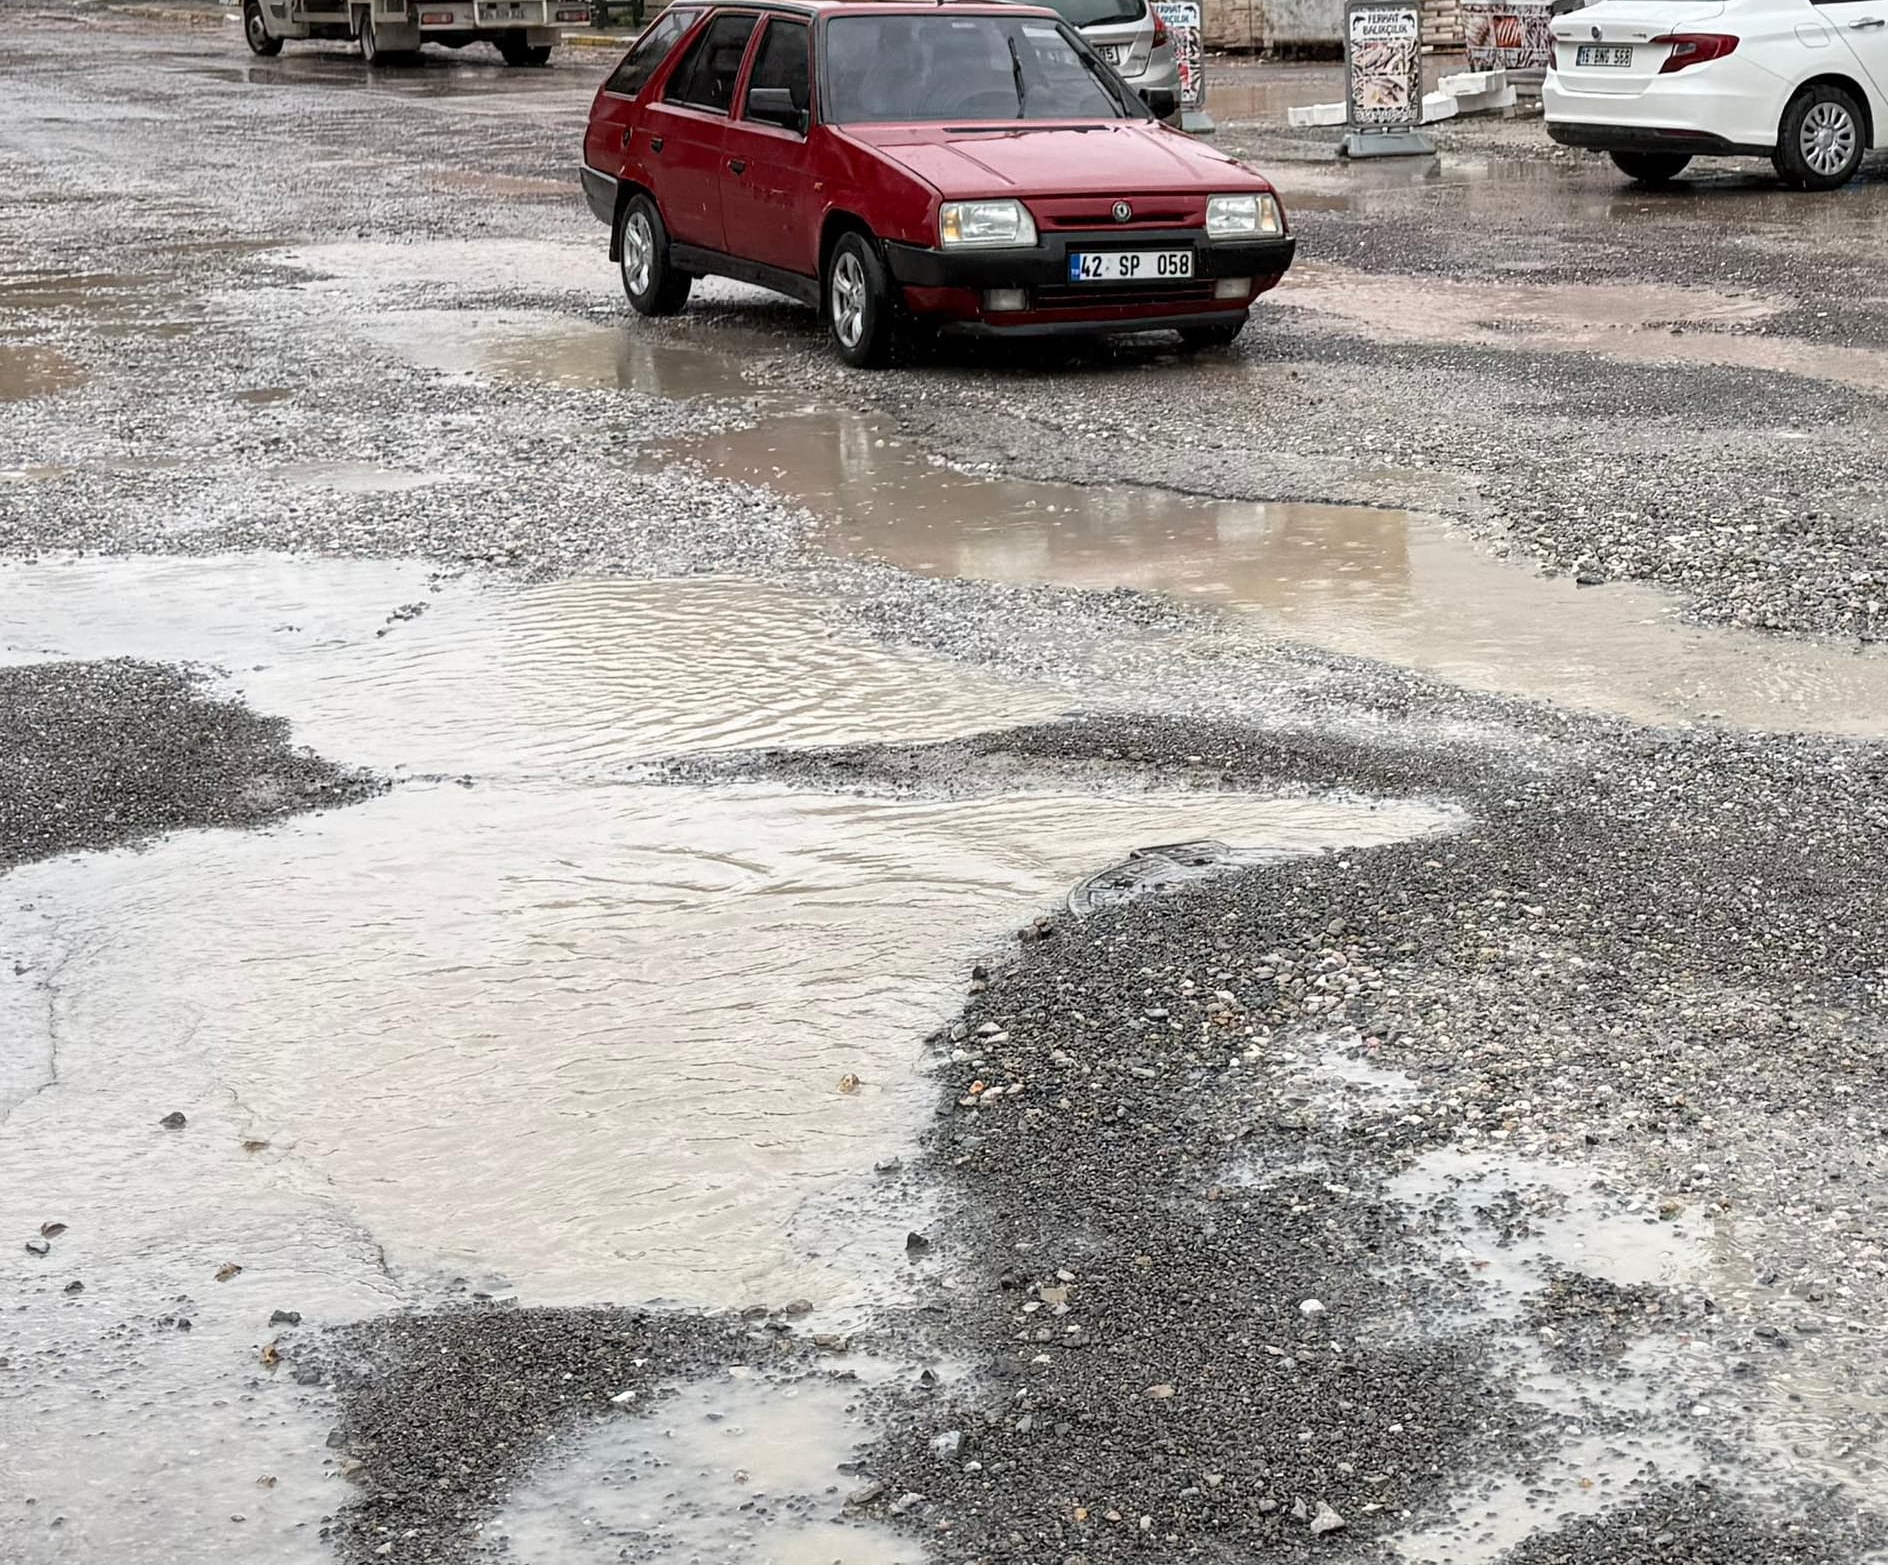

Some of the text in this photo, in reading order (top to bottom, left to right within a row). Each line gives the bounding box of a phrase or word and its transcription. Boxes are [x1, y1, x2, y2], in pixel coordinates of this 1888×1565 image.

[1081, 254, 1189, 277] 42 SP 058
